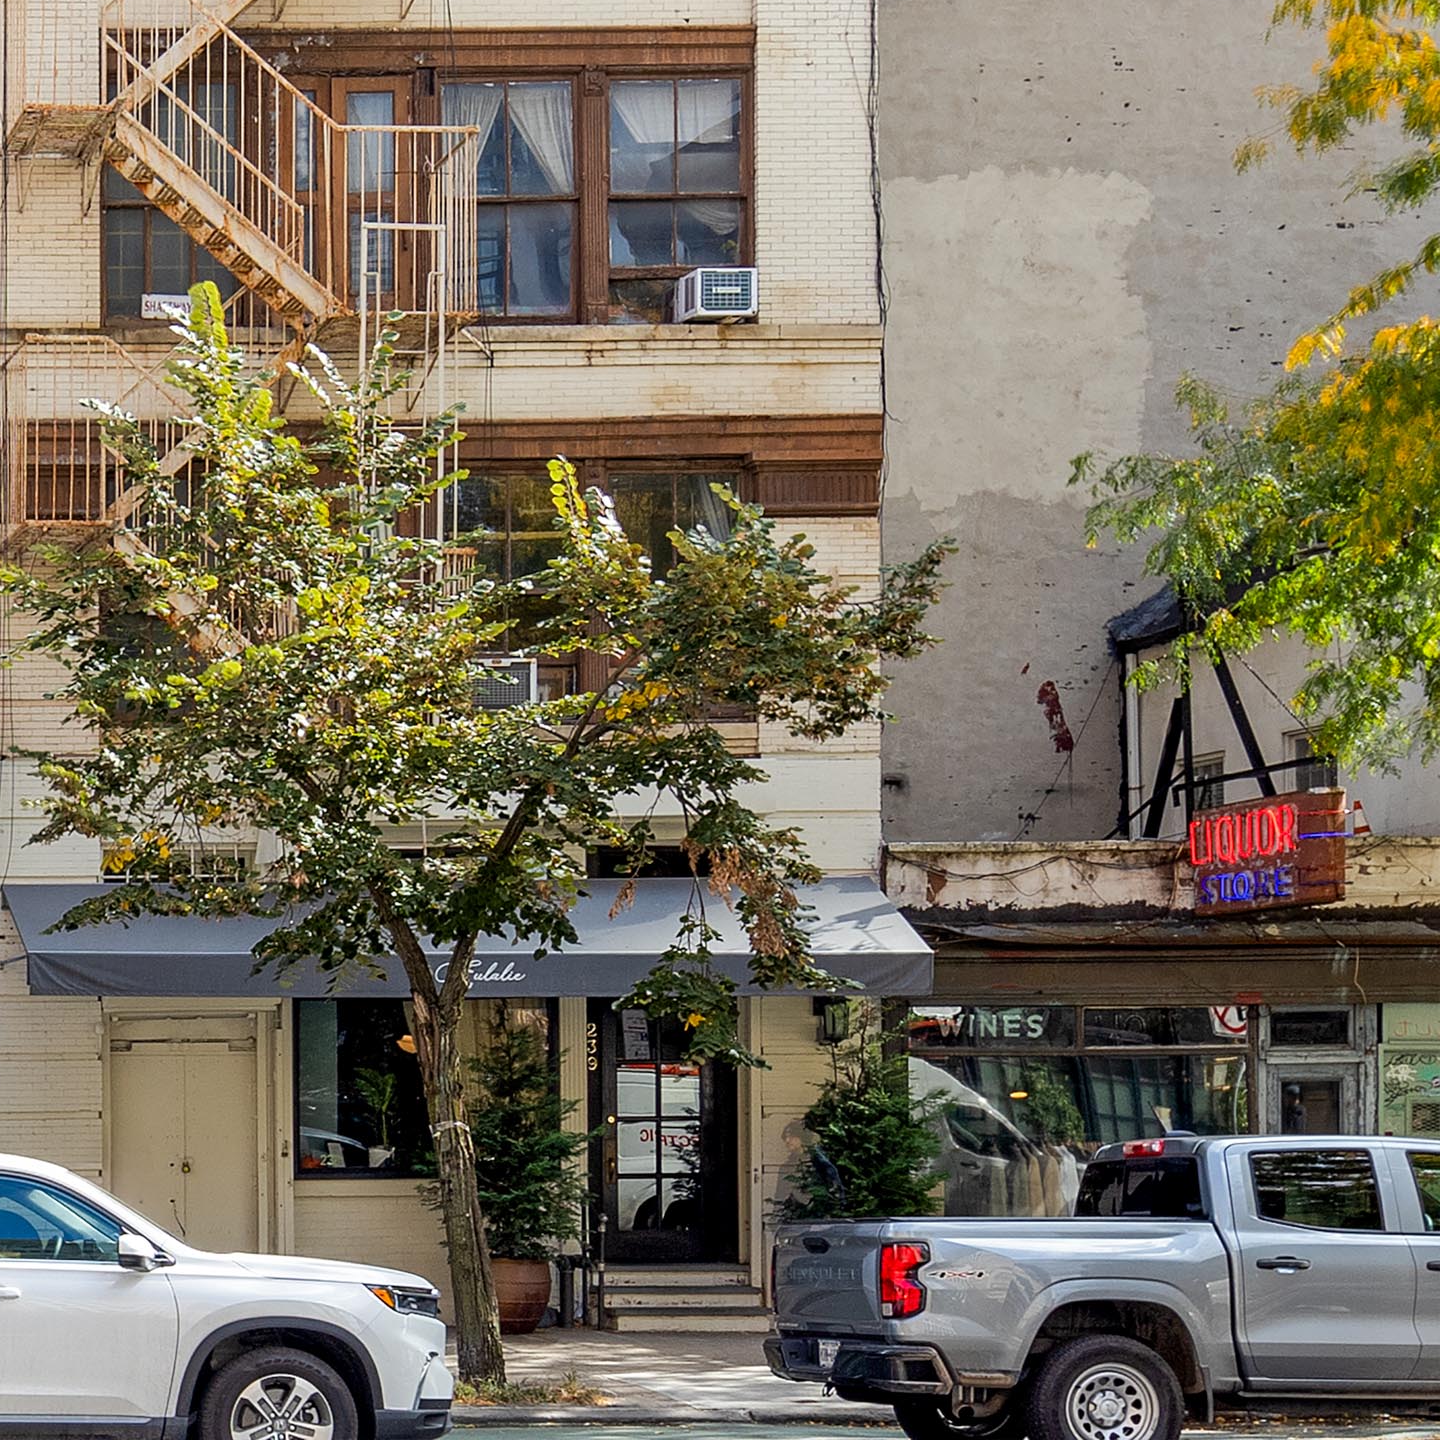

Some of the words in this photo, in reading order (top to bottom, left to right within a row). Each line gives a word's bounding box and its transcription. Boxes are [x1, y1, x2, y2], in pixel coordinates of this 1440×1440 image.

[1189, 803, 1297, 865] LIQUOR
[1201, 866, 1293, 904] STORE
[586, 1022, 599, 1071] 239
[936, 1013, 1044, 1039] WINES
